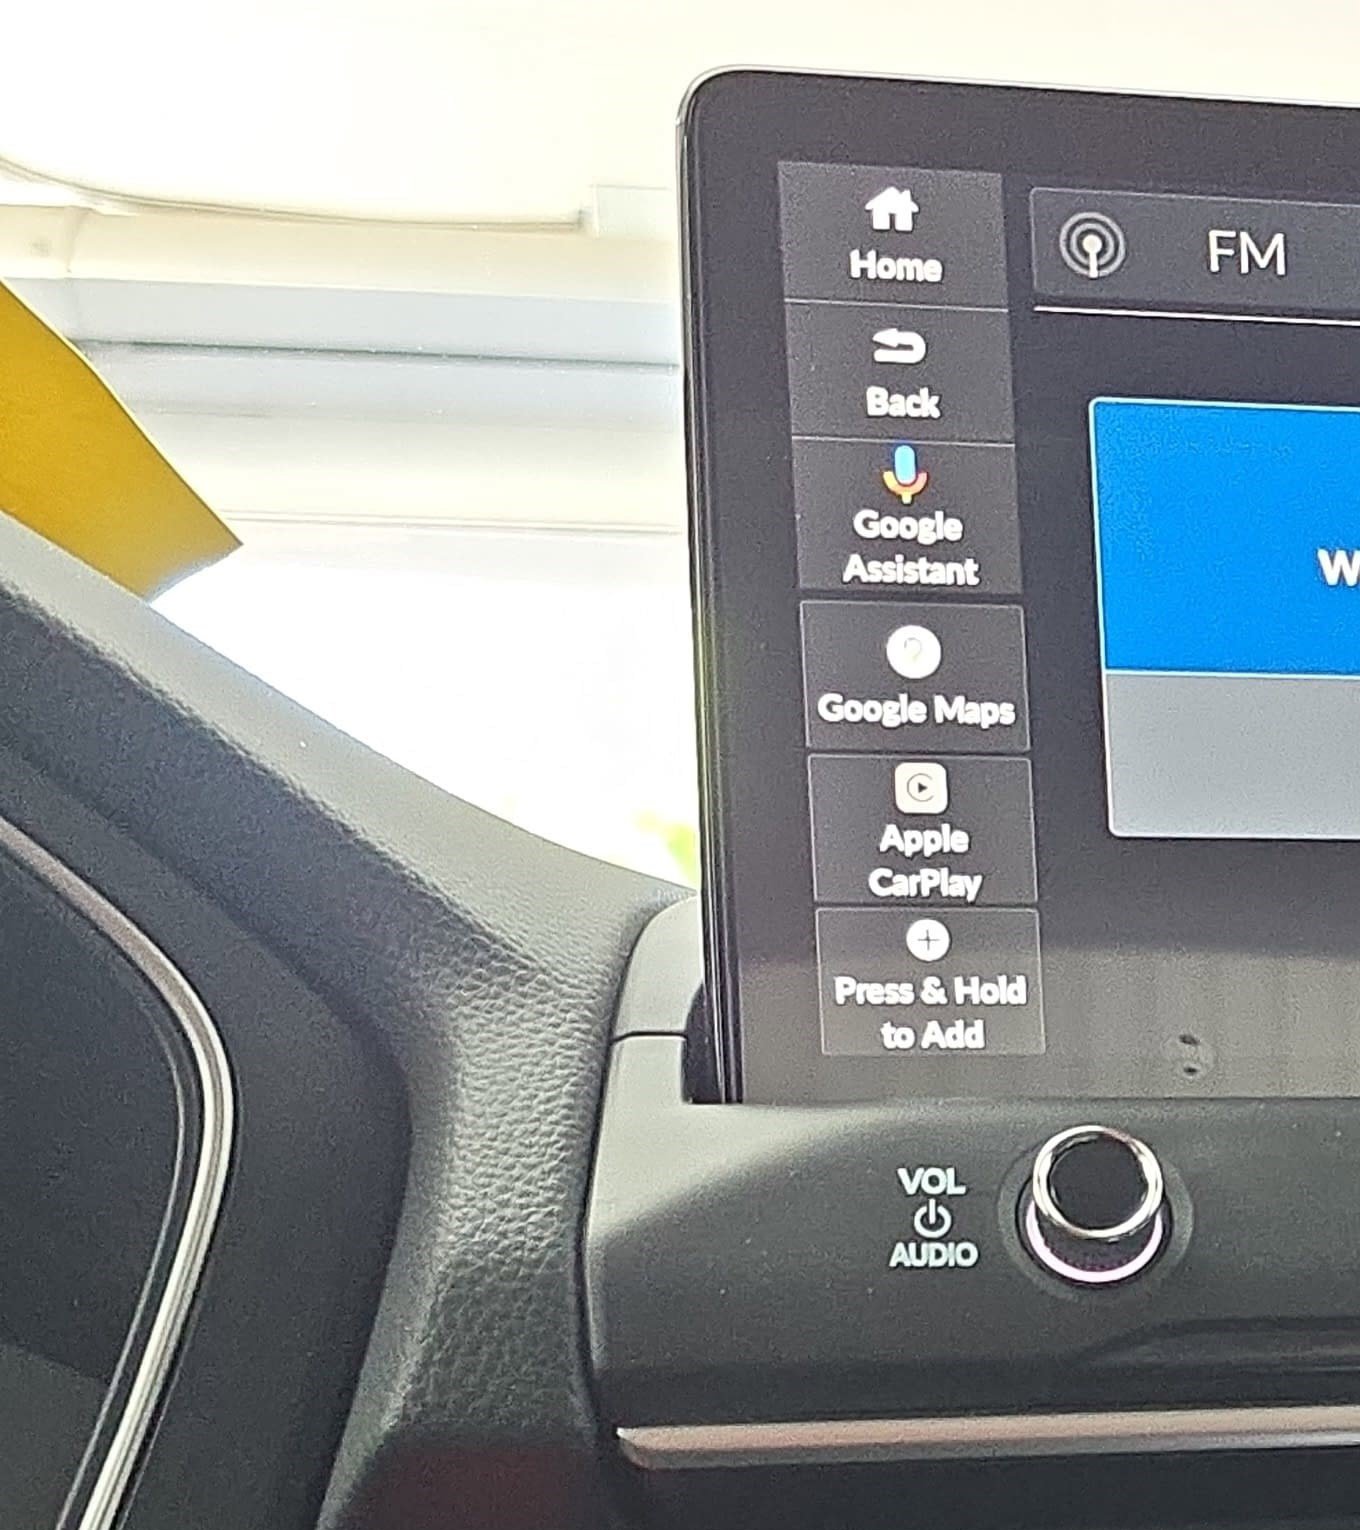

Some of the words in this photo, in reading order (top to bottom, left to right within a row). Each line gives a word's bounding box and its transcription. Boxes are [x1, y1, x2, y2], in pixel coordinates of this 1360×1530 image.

[849, 249, 943, 284] Home
[1207, 228, 1287, 277] FM
[865, 387, 941, 419] Back
[853, 510, 965, 545] Google
[842, 554, 980, 587] Assistant
[817, 694, 928, 729] Google
[935, 694, 1016, 728] Maps
[879, 822, 970, 858] Apple
[868, 867, 983, 904] CarPlay
[834, 976, 915, 1006] Press
[921, 978, 948, 1005] &
[954, 975, 1027, 1007] Hold
[880, 1023, 914, 1050] to
[921, 1020, 986, 1050] Add
[897, 1167, 967, 1197] VOL
[889, 1242, 979, 1269] AUDIO
